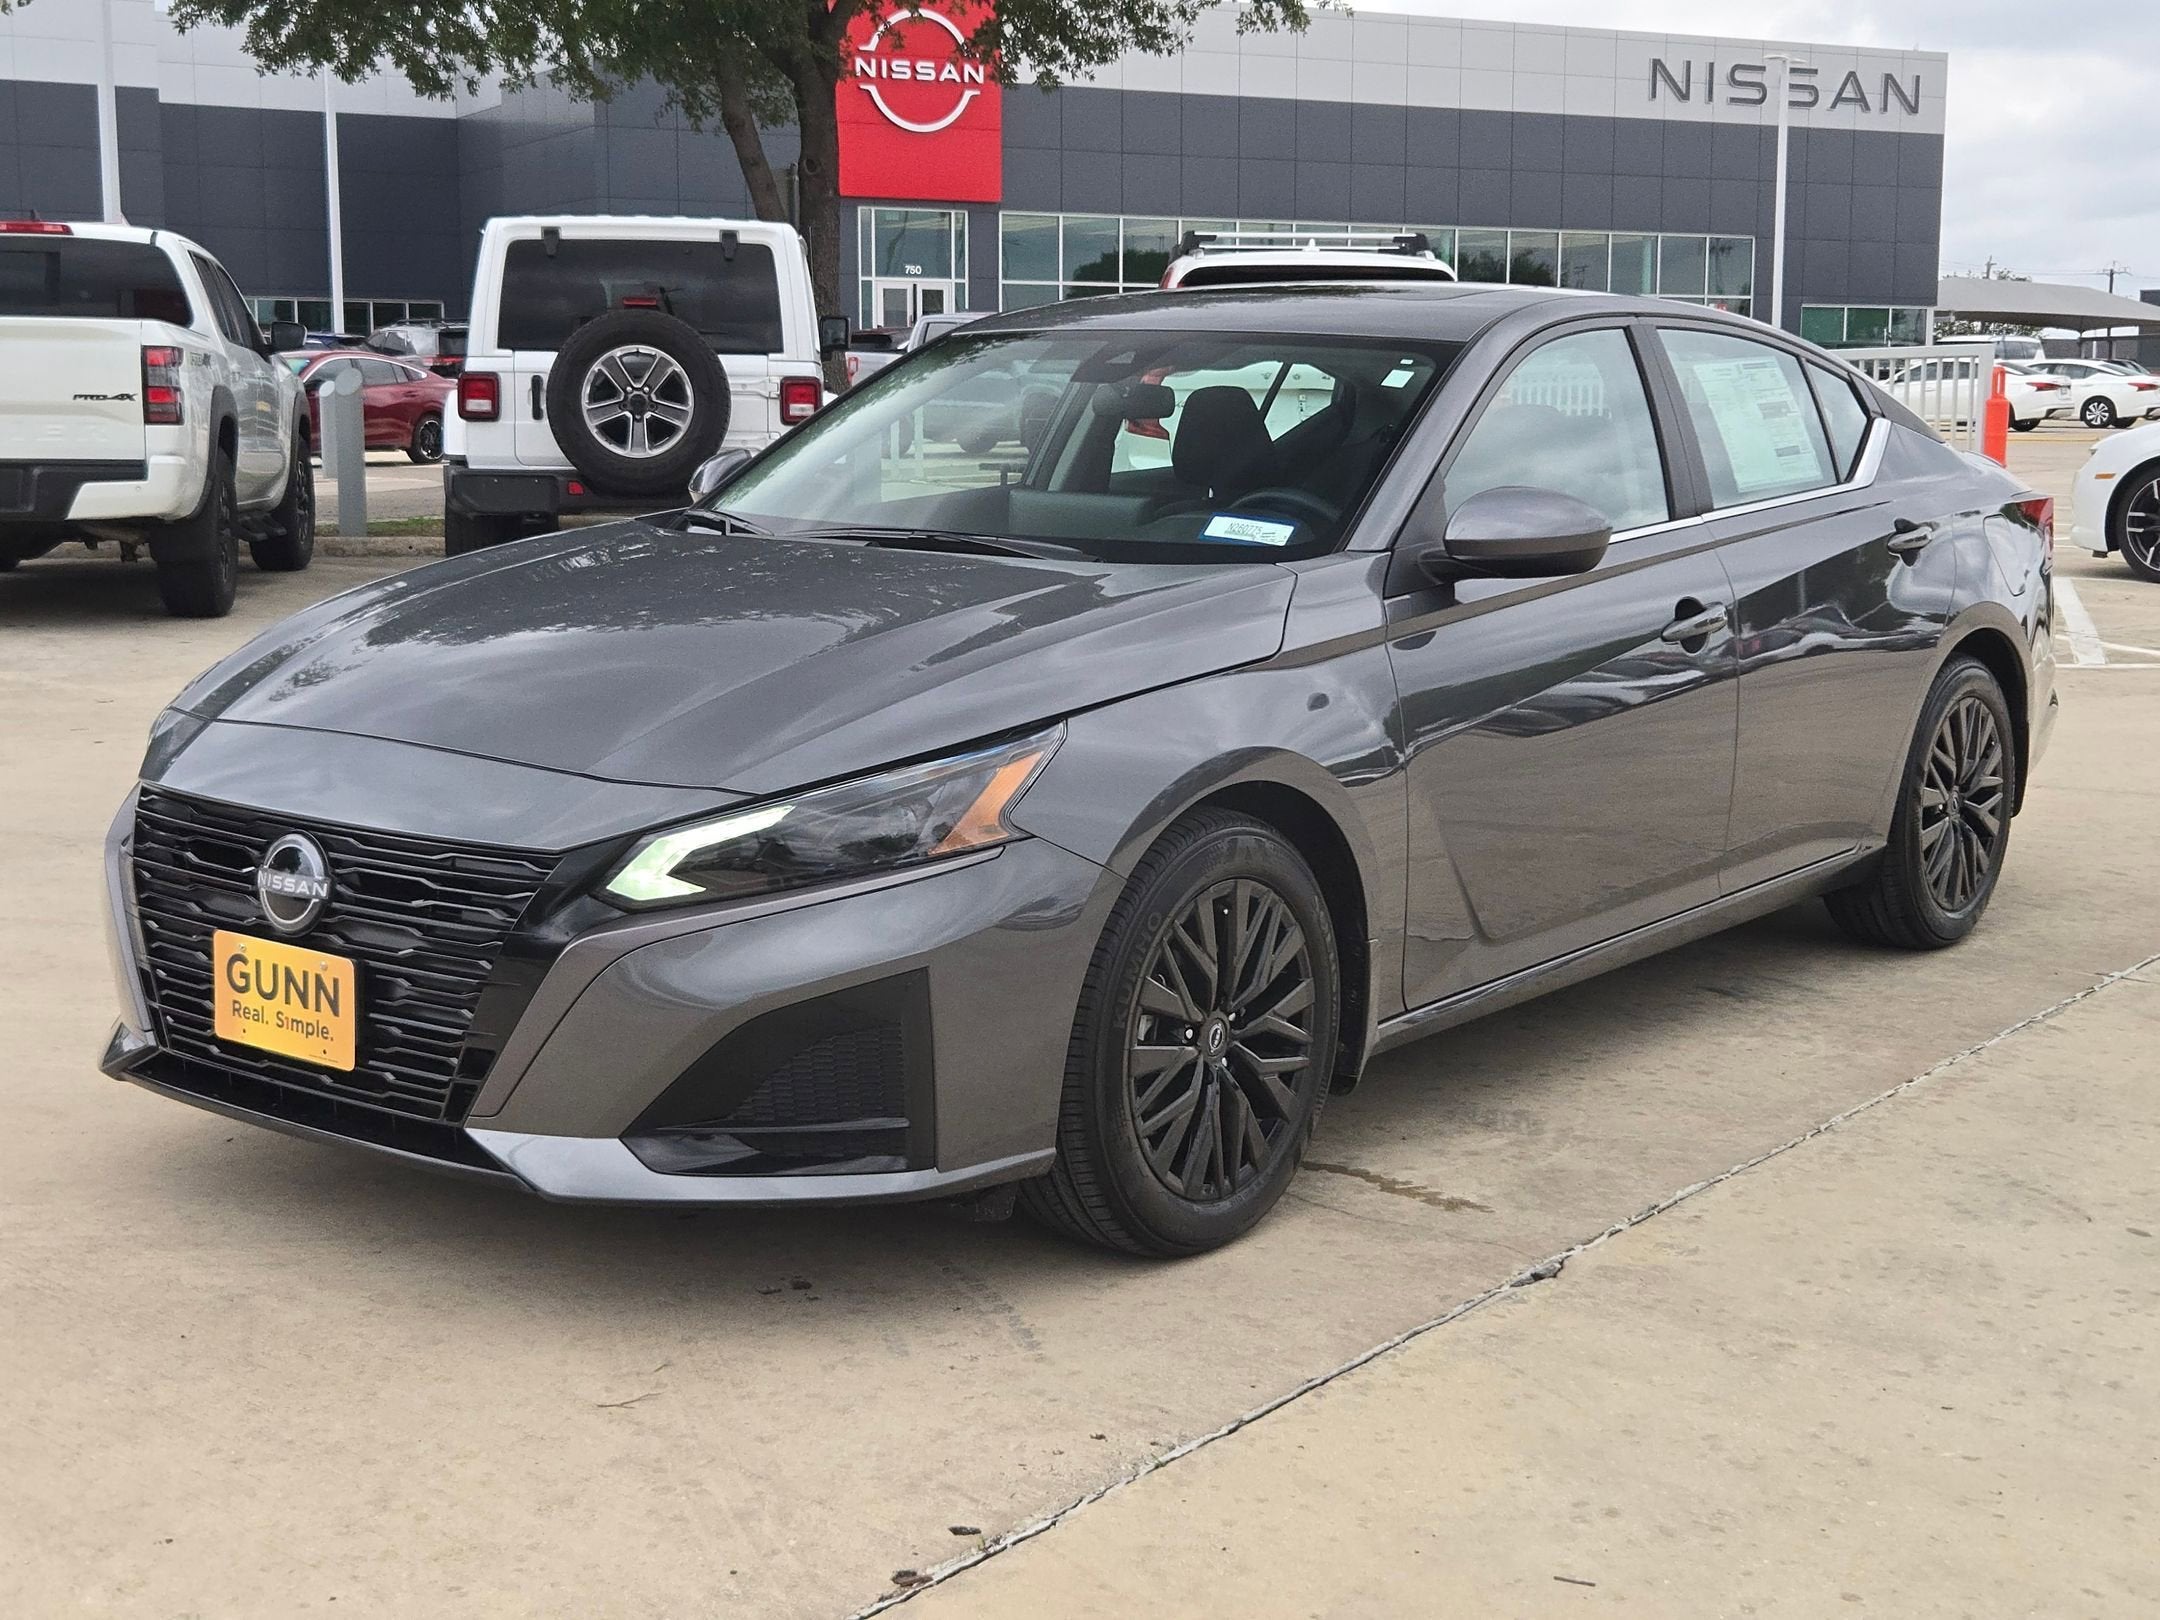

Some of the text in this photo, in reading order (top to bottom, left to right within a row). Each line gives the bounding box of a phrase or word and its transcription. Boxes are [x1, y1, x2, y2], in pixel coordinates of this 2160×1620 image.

[854, 56, 985, 84] NISSAN
[1649, 57, 1921, 115] NISSAN
[904, 265, 923, 275] 750
[258, 870, 328, 897] NISSAN
[226, 953, 340, 1017] GUNN
[232, 1000, 269, 1025] Real.
